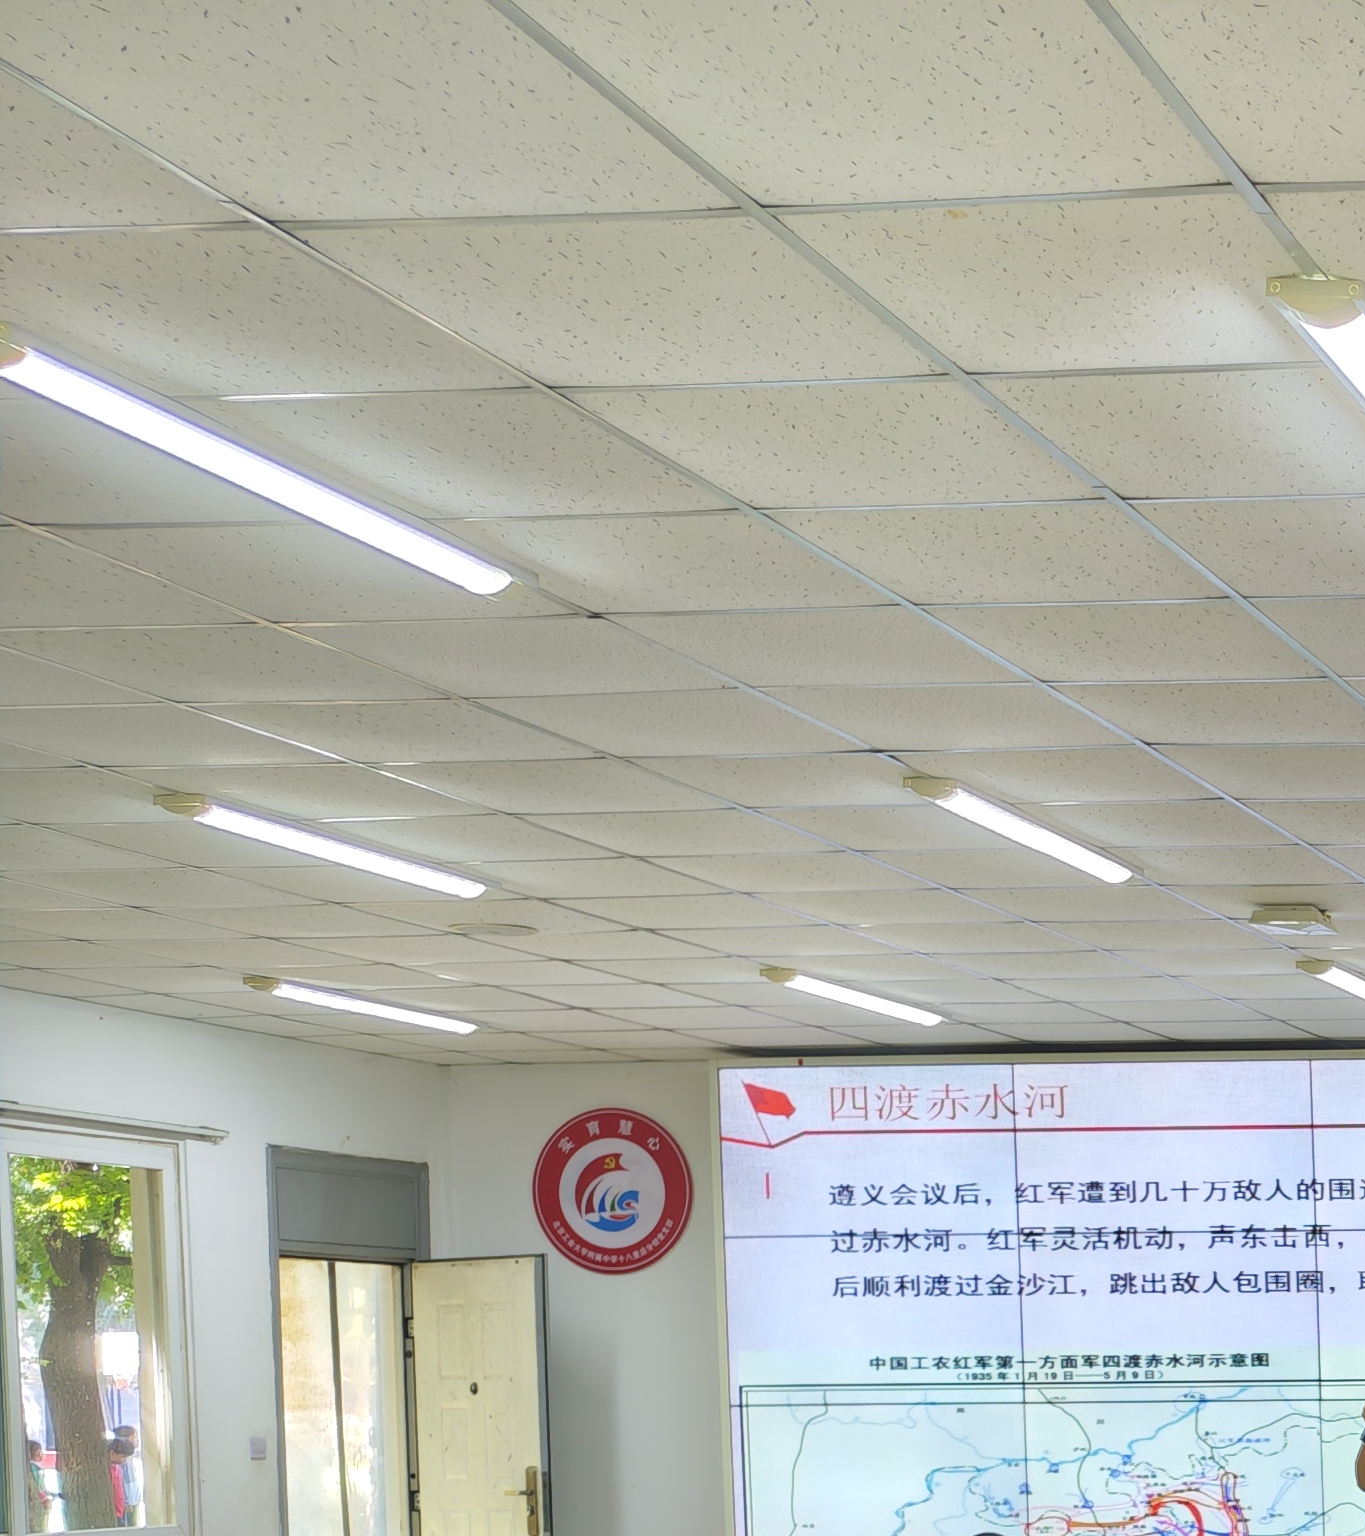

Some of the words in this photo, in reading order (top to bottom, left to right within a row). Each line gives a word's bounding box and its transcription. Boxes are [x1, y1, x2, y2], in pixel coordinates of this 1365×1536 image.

[829, 1083, 1069, 1122] 四渡赤水河
[869, 1353, 1271, 1370] 中国工农红军第一方面军四渡赤水河示意图
